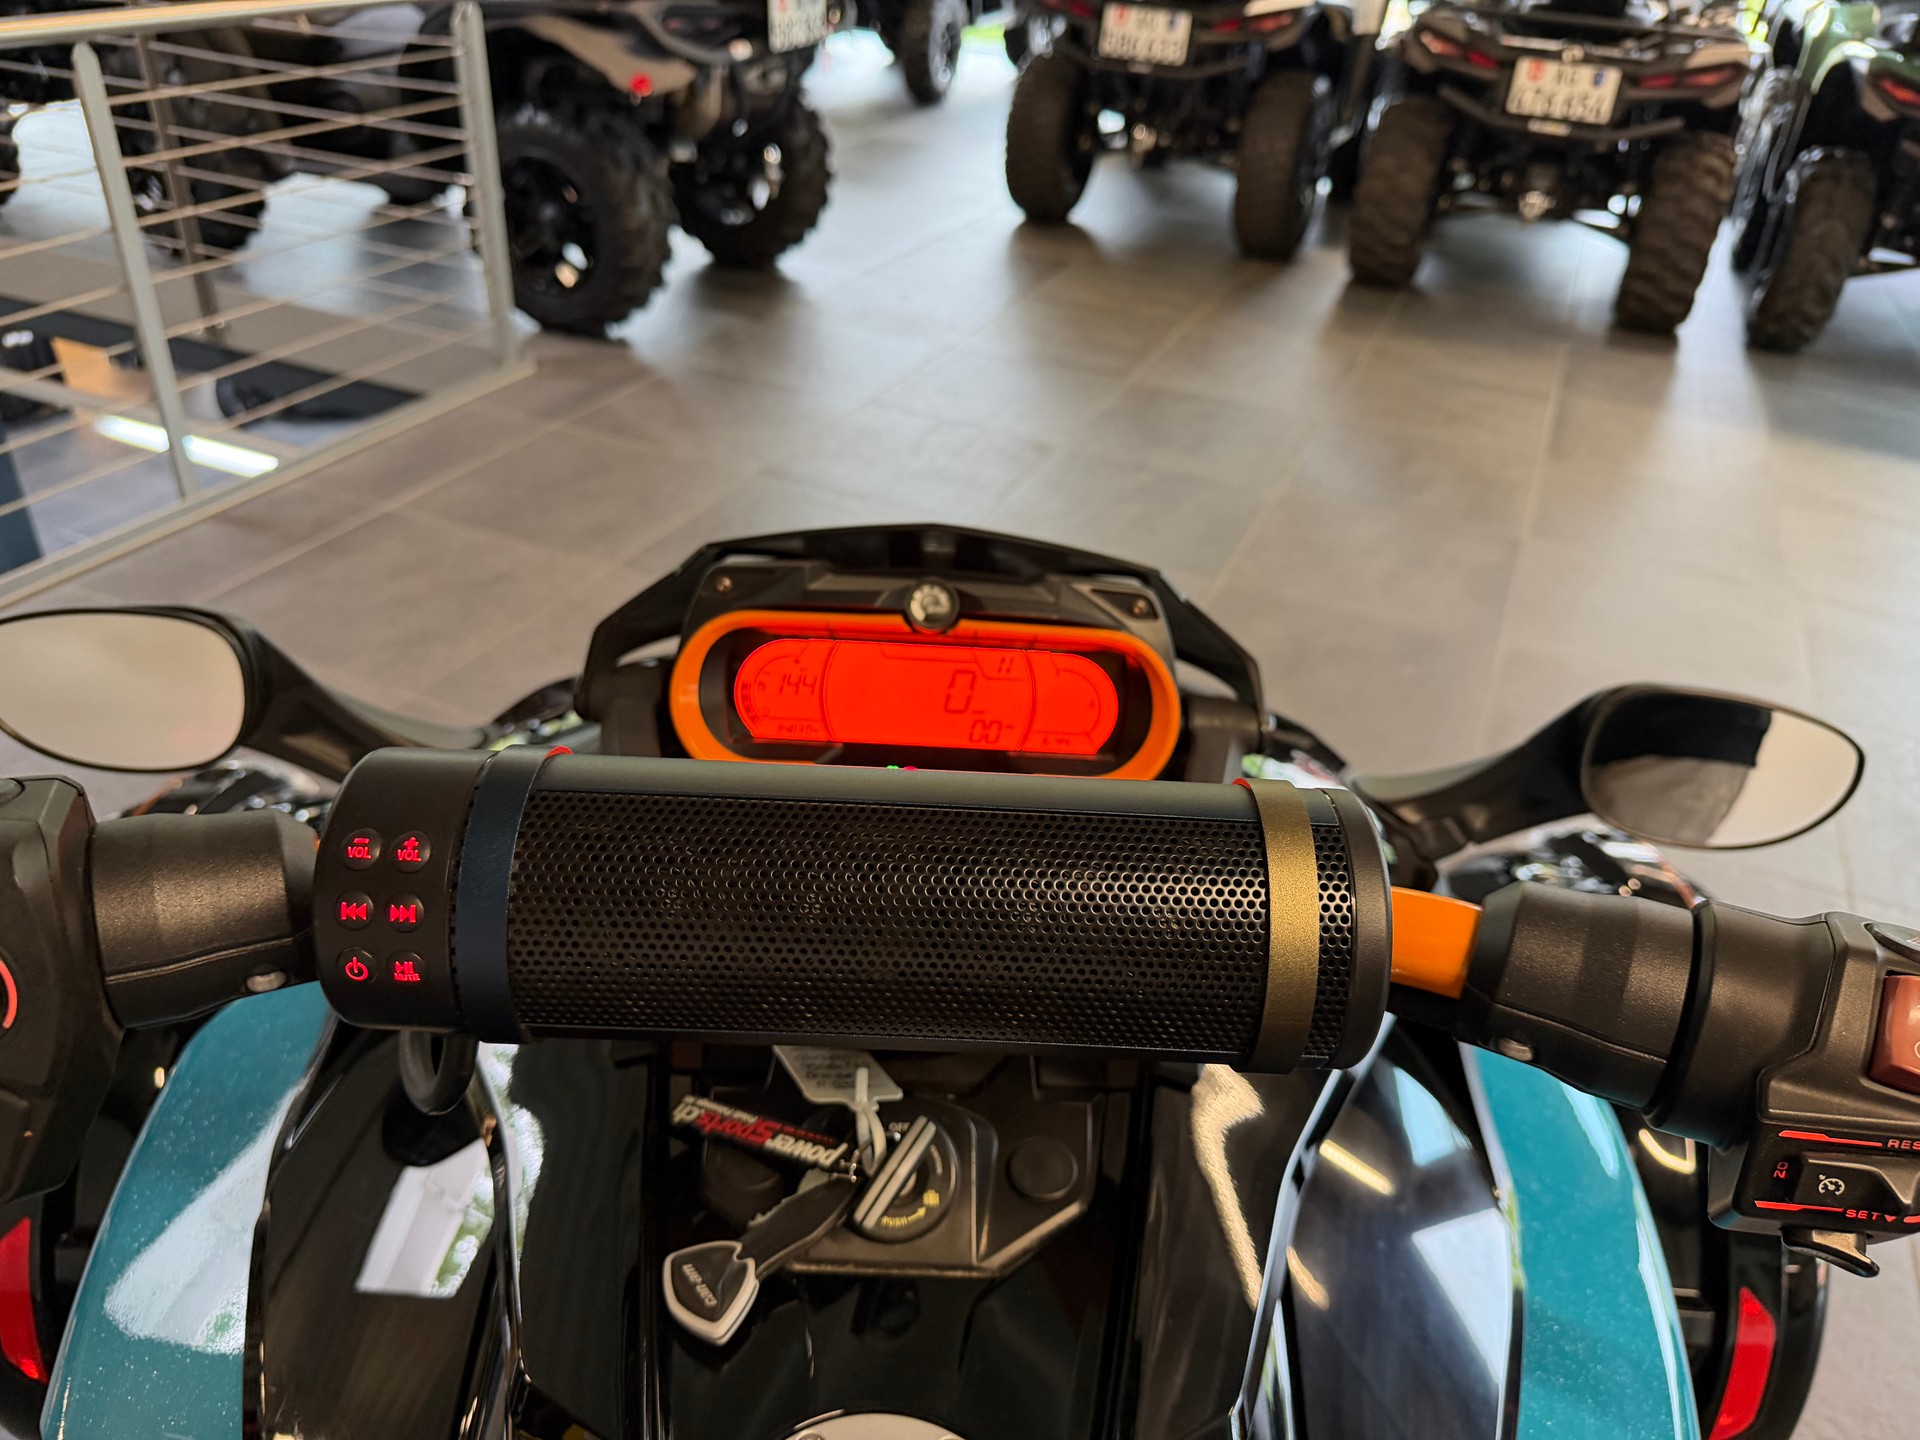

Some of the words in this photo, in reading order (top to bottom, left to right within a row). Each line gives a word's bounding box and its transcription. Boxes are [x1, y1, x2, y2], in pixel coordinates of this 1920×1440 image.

[943, 669, 976, 714] 0
[347, 846, 372, 859] VOL
[397, 849, 422, 862] VOL
[393, 972, 421, 982] MUTE
[1845, 1209, 1880, 1221] SET
